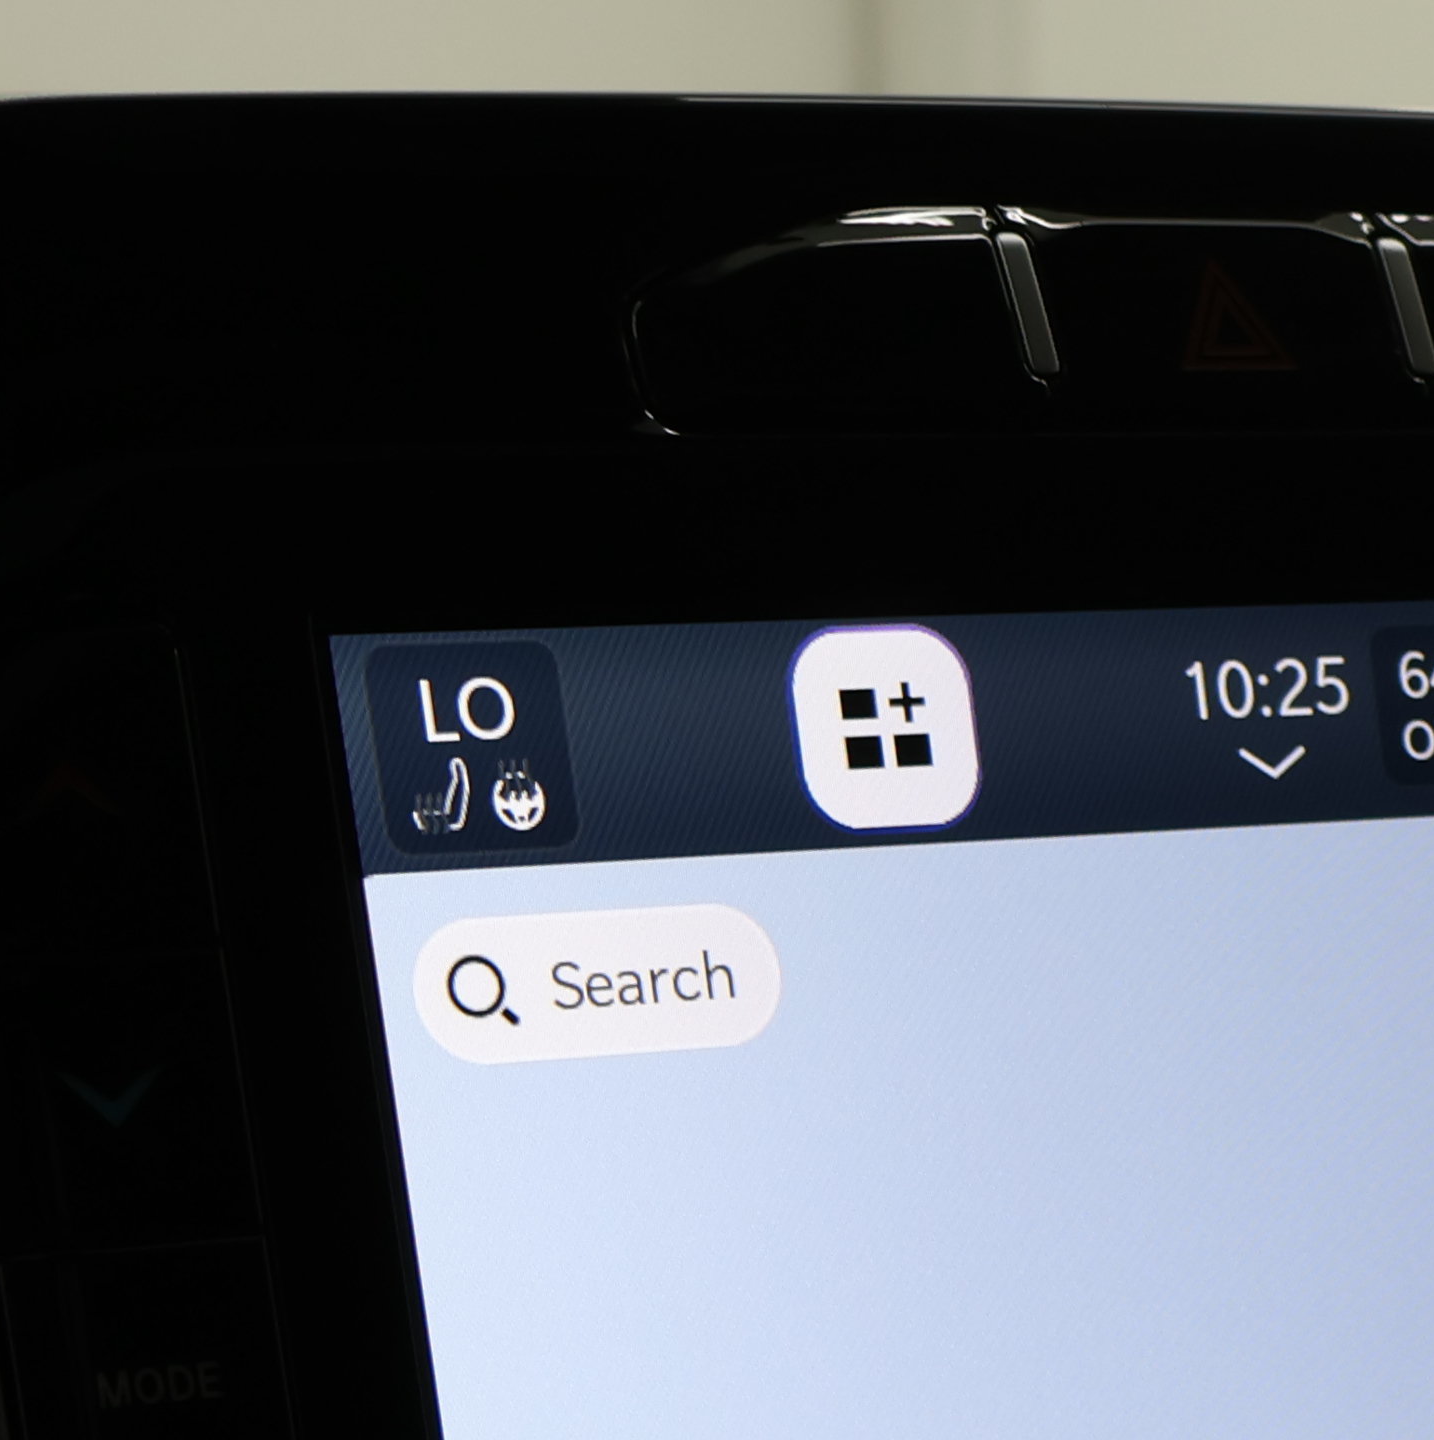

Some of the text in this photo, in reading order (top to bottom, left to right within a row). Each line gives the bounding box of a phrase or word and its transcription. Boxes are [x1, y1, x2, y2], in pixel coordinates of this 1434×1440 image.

[418, 676, 515, 743] LO
[1185, 655, 1350, 720] 10:25
[551, 950, 735, 1010] Search
[96, 1361, 225, 1408] MODE
